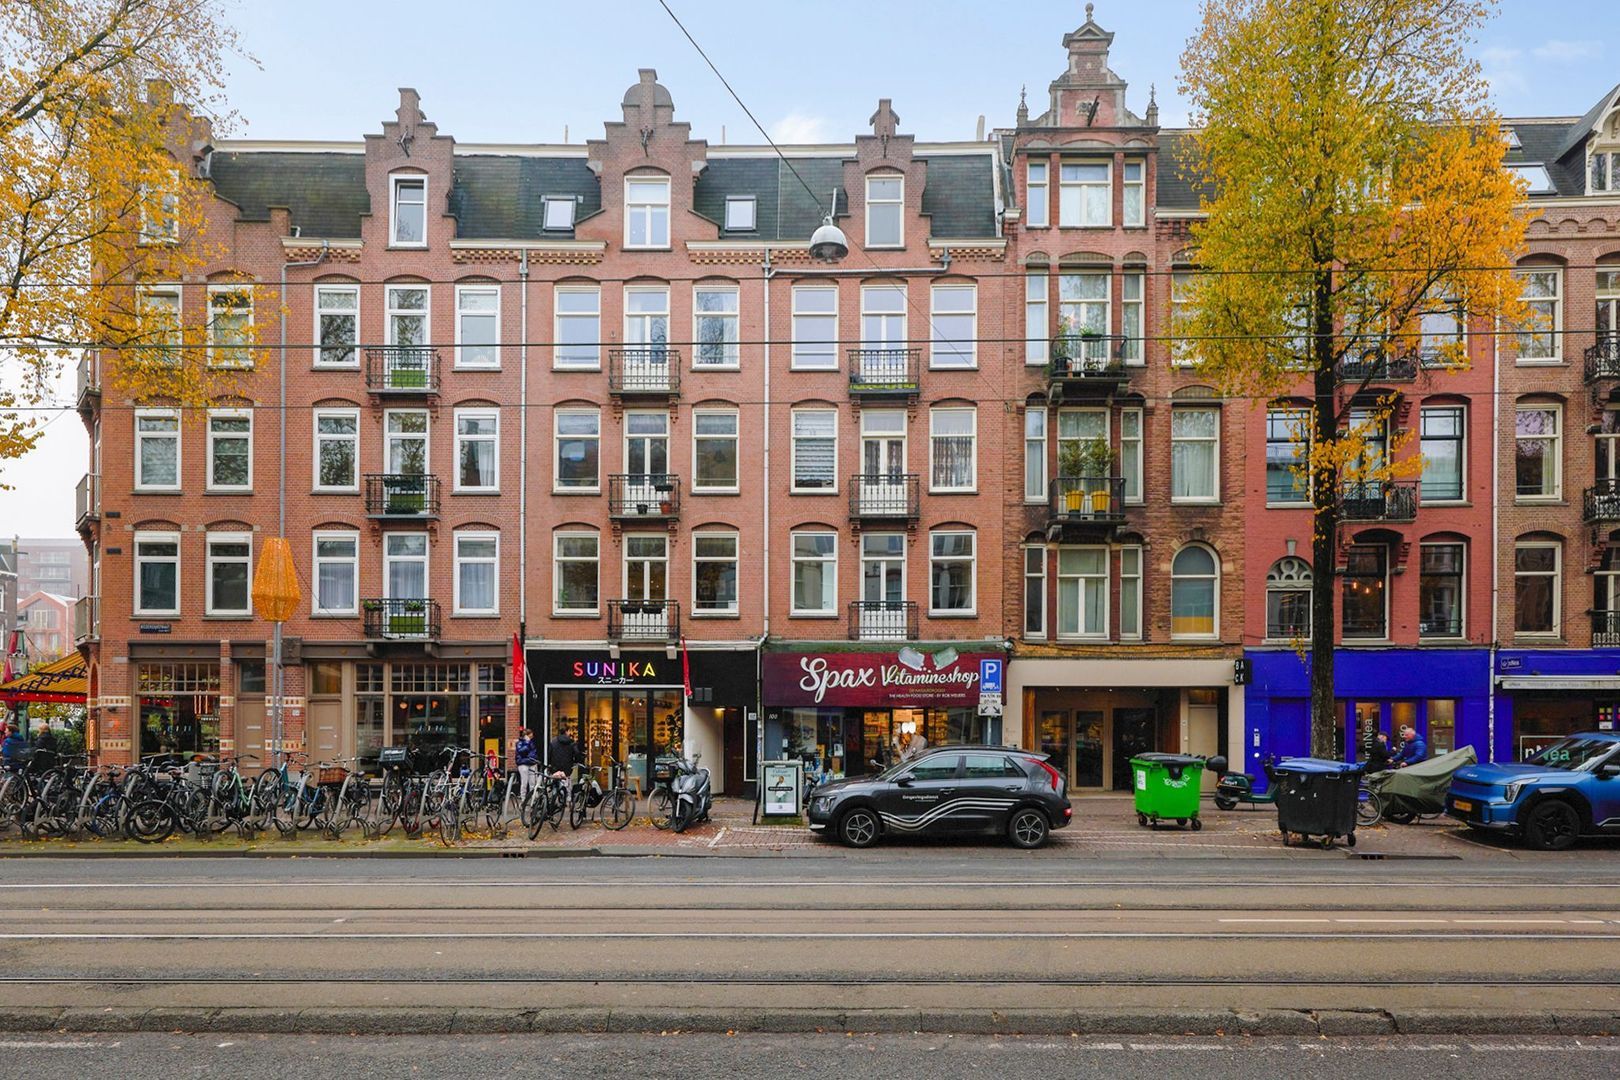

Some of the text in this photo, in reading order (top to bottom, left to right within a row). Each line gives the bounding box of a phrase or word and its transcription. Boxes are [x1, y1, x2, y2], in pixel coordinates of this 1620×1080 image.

[573, 662, 656, 677] SUNIKA
[985, 663, 997, 679] P
[598, 676, 635, 684] スニーカー
[800, 656, 980, 703] Spax Vitamineshop
